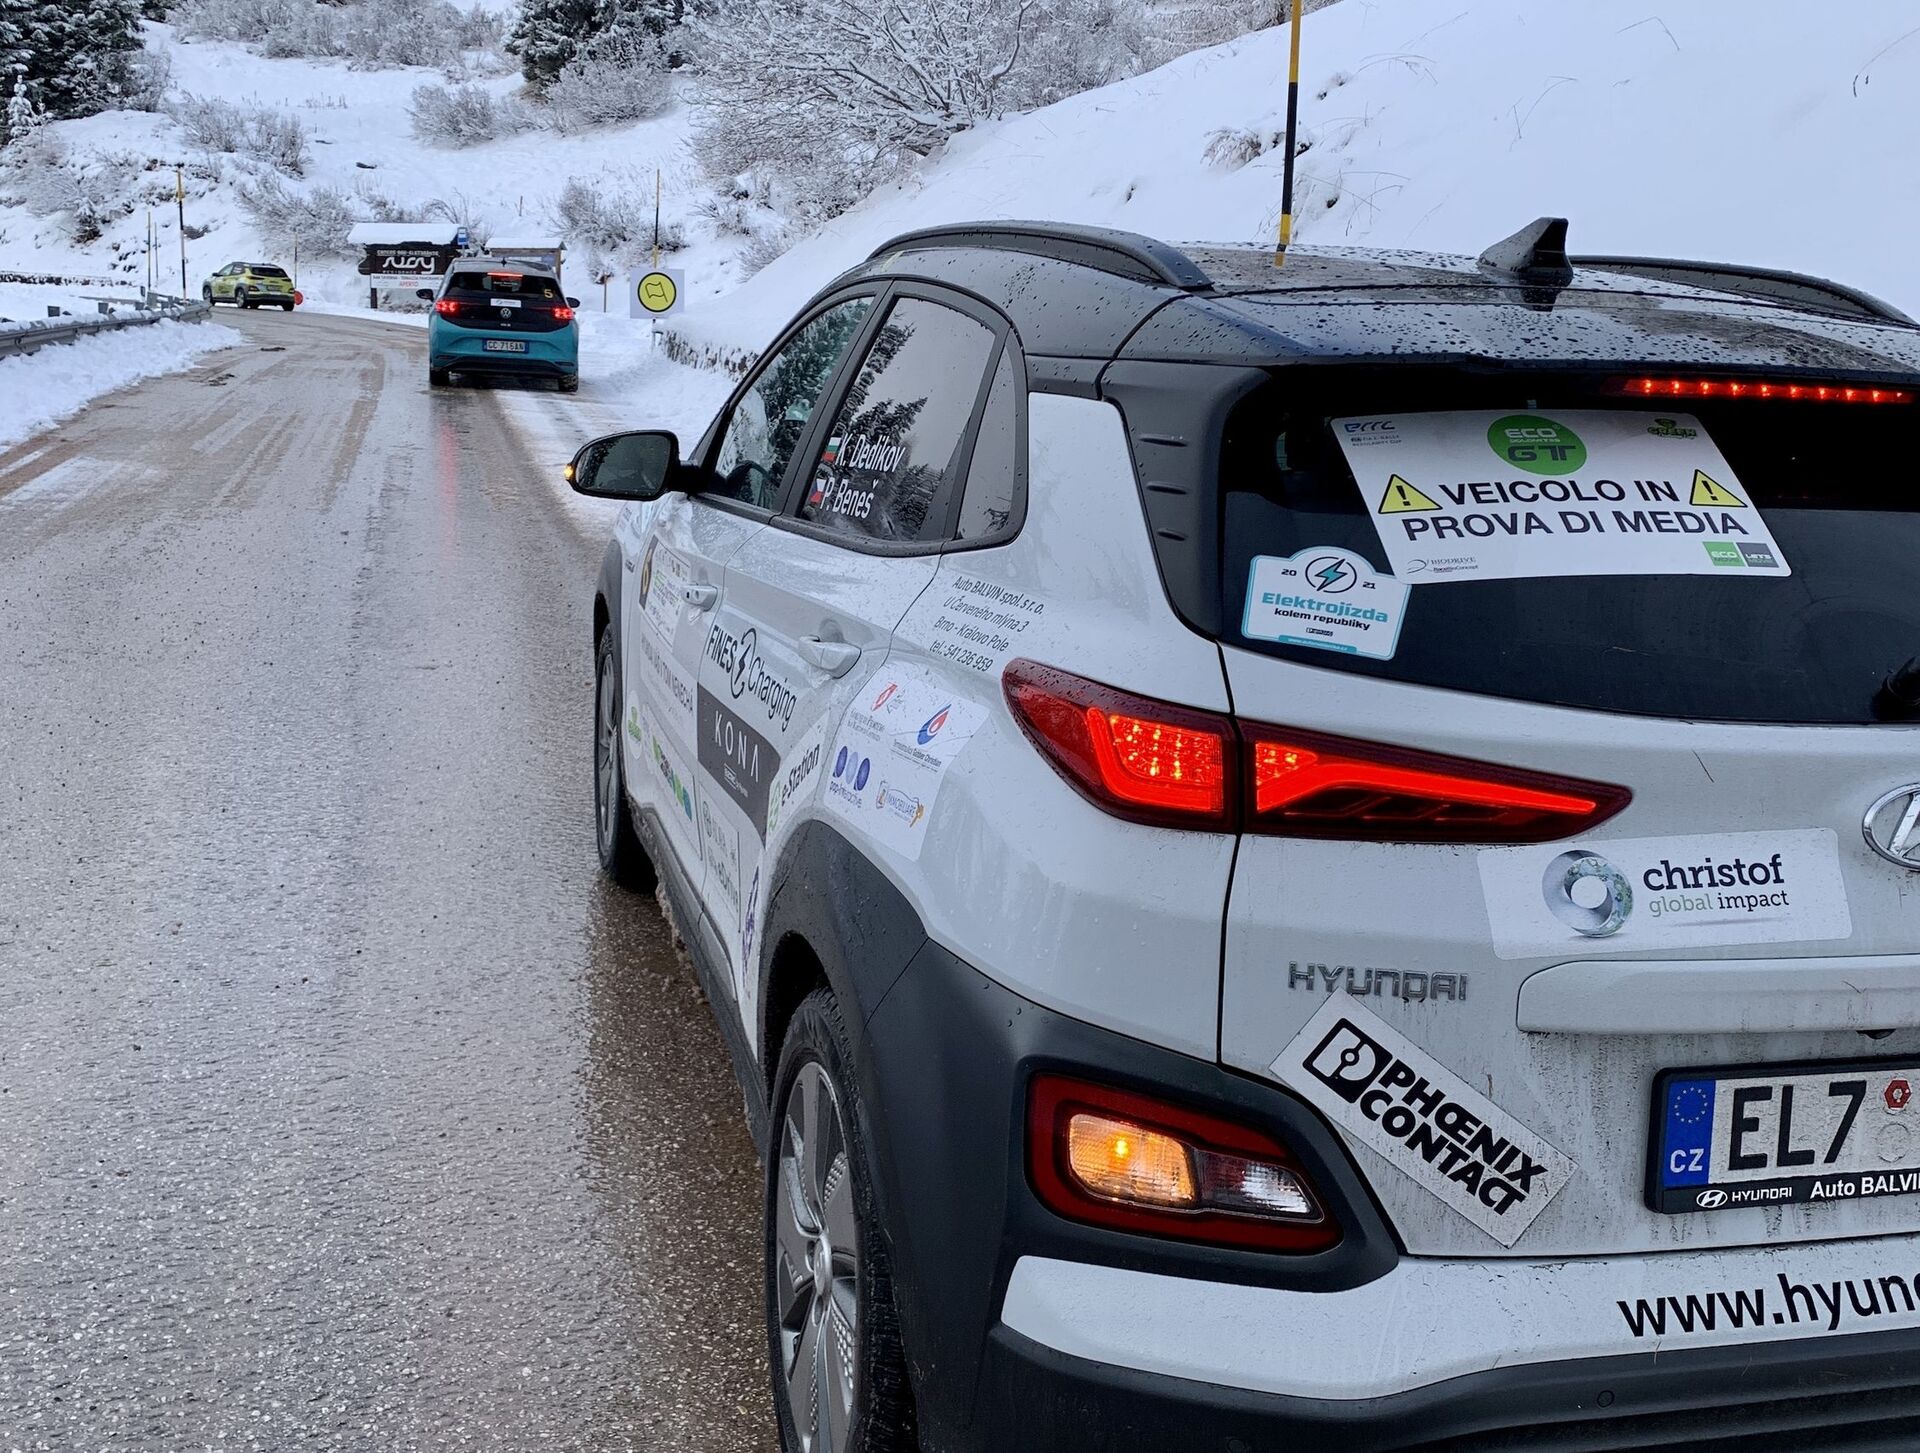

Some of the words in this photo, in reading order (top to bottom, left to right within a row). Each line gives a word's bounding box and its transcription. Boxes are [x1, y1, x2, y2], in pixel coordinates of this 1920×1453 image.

[543, 289, 554, 299] 5
[1504, 427, 1557, 438] ECO
[835, 433, 853, 467] K.
[1508, 445, 1577, 462] GT
[820, 477, 836, 511] P.
[832, 479, 879, 519] Beneš
[1438, 479, 1626, 506] VEICOLO
[1639, 480, 1681, 503] IN
[1401, 511, 1554, 542] PROVA
[1559, 511, 1604, 534] DI
[1616, 511, 1750, 536] MEDIA
[1281, 568, 1297, 577] 20
[1362, 581, 1376, 590] 21
[952, 576, 974, 592] Auto
[970, 580, 1005, 600] BALVIN
[999, 593, 1024, 607] spol.
[950, 595, 994, 621] Červeného
[990, 613, 1019, 630] mlýna
[1017, 620, 1030, 633] 3
[1262, 592, 1388, 623] Elektrojízda
[1274, 608, 1311, 620] kolem
[1313, 614, 1371, 631] republiky
[933, 616, 955, 632] Brno
[956, 623, 990, 645] Královo
[987, 634, 1009, 652] Pole
[929, 640, 947, 655] tel.:
[943, 644, 960, 659] 541
[956, 649, 977, 666] 236
[972, 655, 994, 672] 959
[706, 624, 738, 674] FINES
[748, 656, 797, 733] Charging
[781, 743, 820, 807] e-Station
[1643, 853, 1785, 891] christof
[1649, 893, 1714, 918] global
[1717, 890, 1790, 912] impact
[1288, 961, 1469, 1000] HYUNDAI
[1728, 1080, 1867, 1171] EL7
[1359, 1089, 1527, 1217] CONTACT
[1669, 1148, 1705, 1173] CZ
[1731, 1186, 1793, 1202] HYUNDAI
[1810, 1179, 1856, 1199] Auto
[1861, 1172, 1920, 1195] BALVI
[1616, 1272, 1920, 1338] www.hyun
